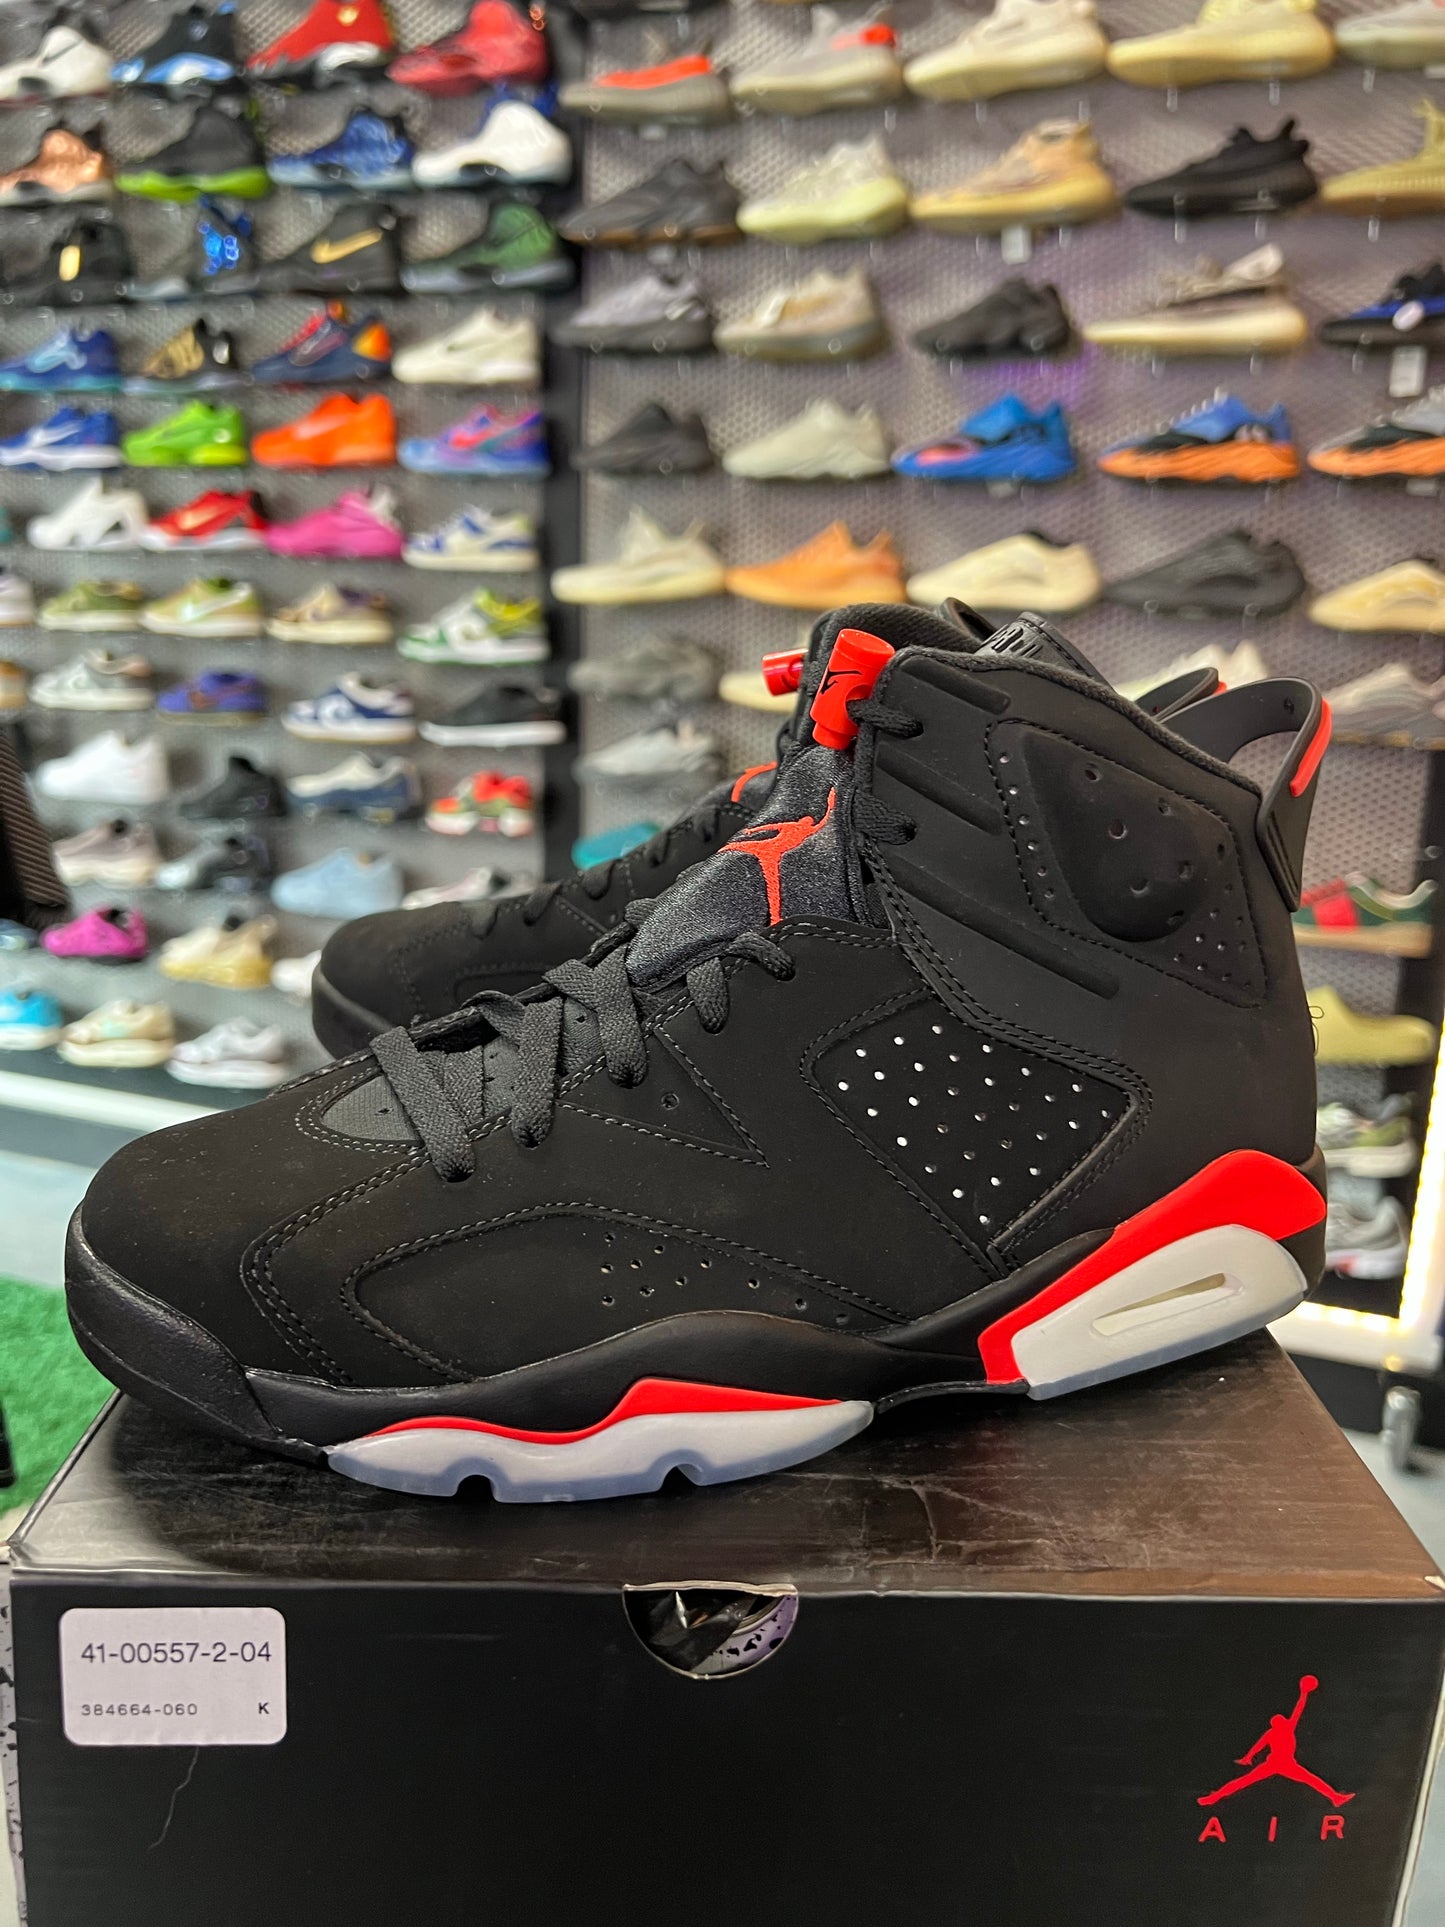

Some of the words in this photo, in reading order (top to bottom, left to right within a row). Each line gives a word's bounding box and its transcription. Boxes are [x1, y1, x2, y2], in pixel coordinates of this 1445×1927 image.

[80, 1641, 272, 1664] 41-00557-2-04
[80, 1703, 199, 1717] 384664-060
[257, 1702, 270, 1715] K
[1198, 1814, 1346, 1843] AIR
